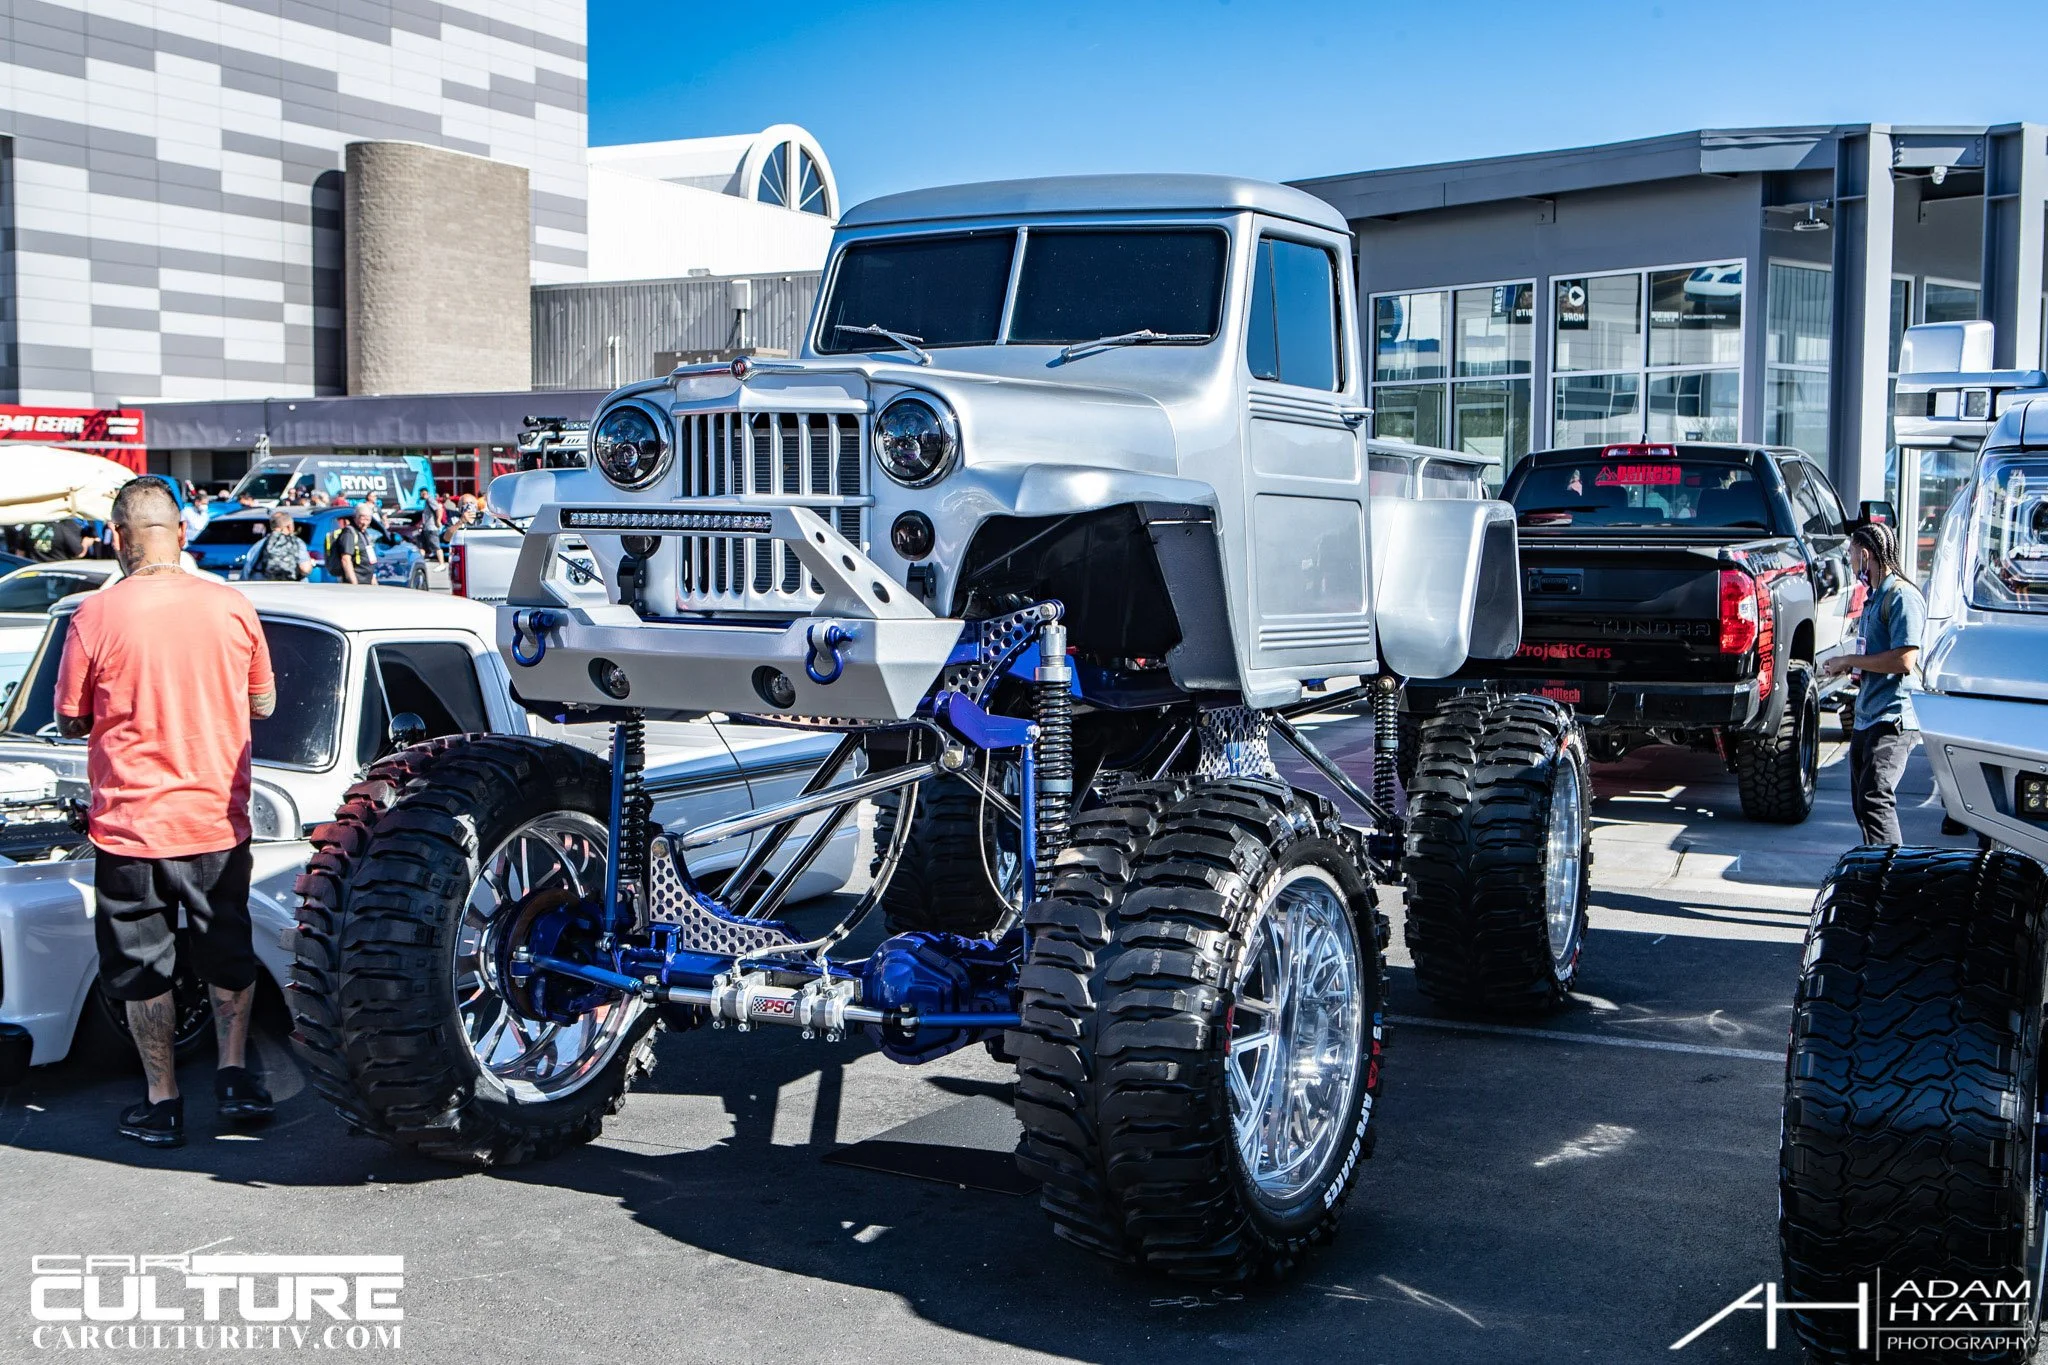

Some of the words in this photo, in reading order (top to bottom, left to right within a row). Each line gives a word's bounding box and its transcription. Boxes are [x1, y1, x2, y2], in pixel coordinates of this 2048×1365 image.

[34, 415, 85, 433] GEAR
[340, 475, 388, 490] RYNO
[1593, 617, 1711, 636] TUNDRA
[1518, 642, 1612, 662] ProjektCars
[1542, 686, 1581, 702] belltech
[763, 999, 795, 1014] PSC
[1372, 1012, 1383, 1056] USA
[1323, 1136, 1361, 1210] BRAKES
